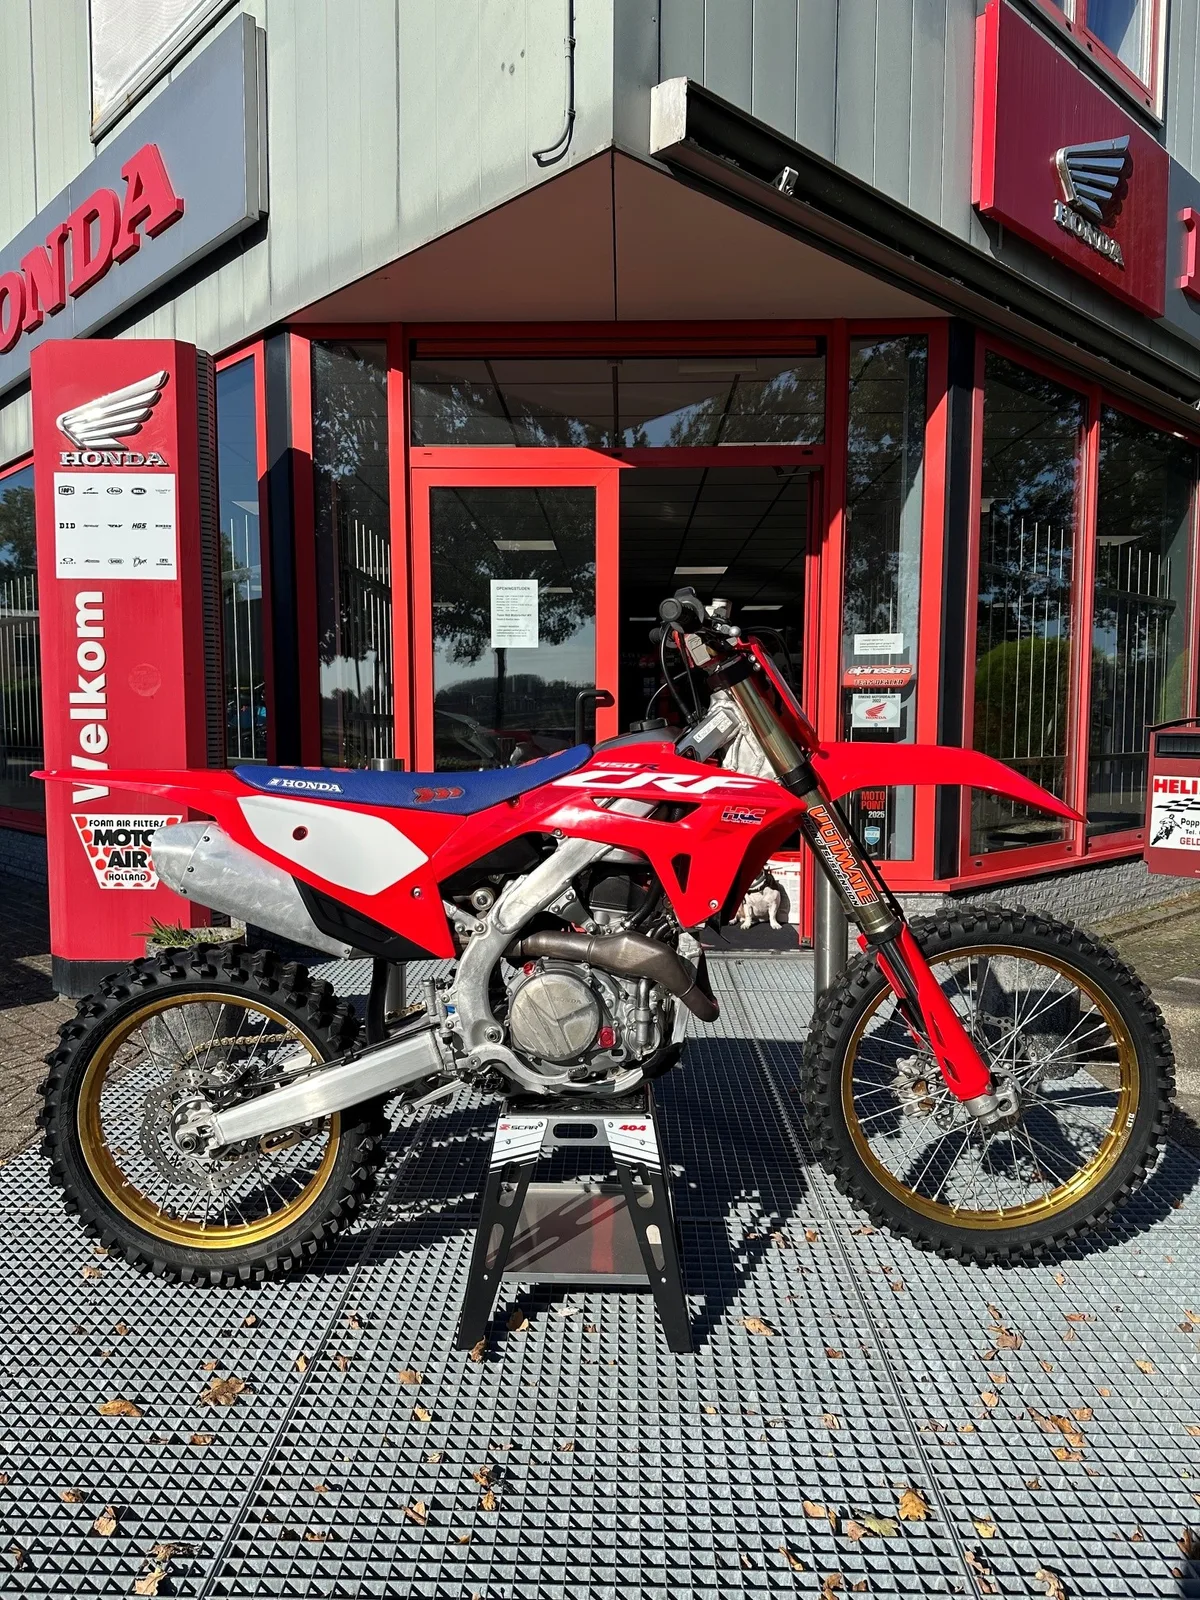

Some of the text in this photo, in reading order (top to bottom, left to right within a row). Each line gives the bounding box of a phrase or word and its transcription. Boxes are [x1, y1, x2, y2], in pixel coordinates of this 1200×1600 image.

[1053, 199, 1125, 267] HONDA
[59, 451, 169, 467] HONDA
[848, 666, 911, 675] alpinestars
[69, 591, 110, 804] Welkom
[281, 779, 343, 793] HONDA
[552, 771, 769, 794] CRF
[1153, 778, 1198, 795] HELI
[861, 791, 886, 801] MOTO
[861, 801, 886, 810] POINT
[721, 806, 767, 822] HRC
[868, 811, 885, 819] 2025
[108, 851, 147, 868] AIR
[109, 873, 147, 881] HOLLAND
[618, 1124, 647, 1132] 404
